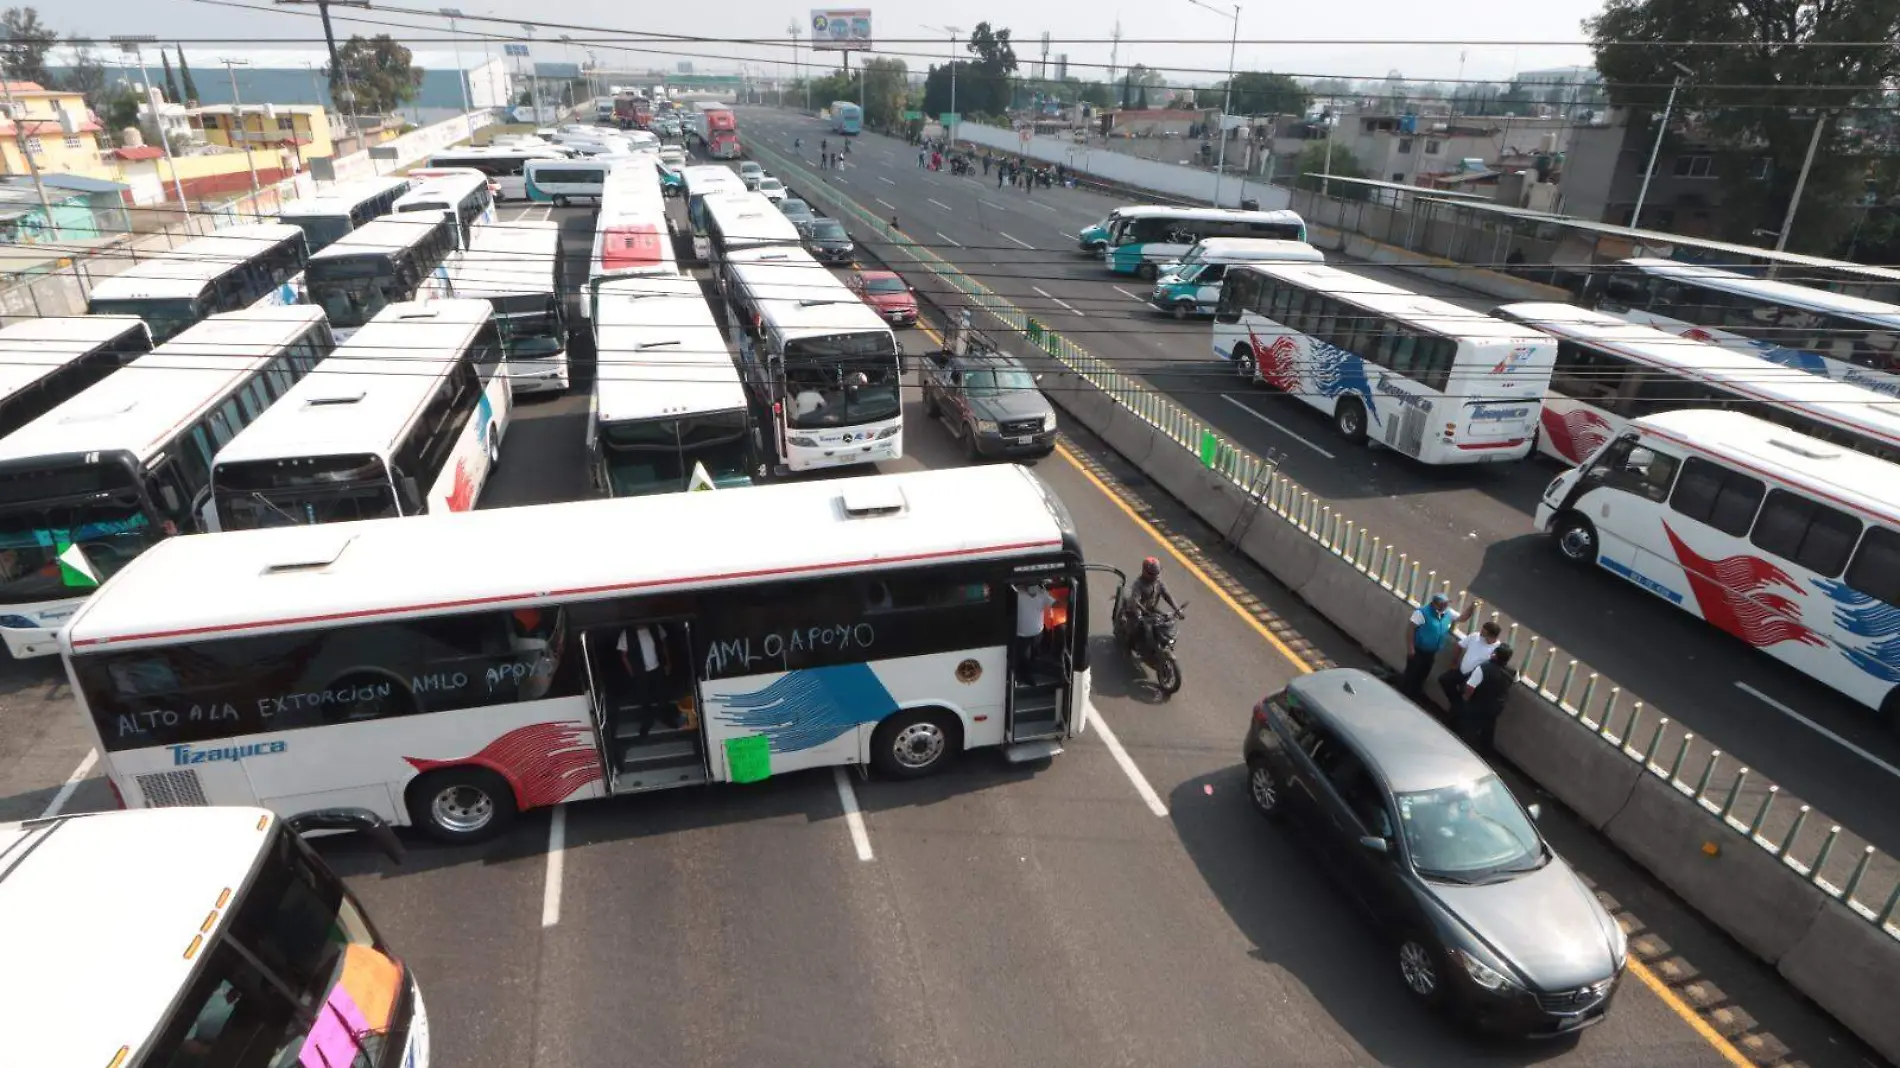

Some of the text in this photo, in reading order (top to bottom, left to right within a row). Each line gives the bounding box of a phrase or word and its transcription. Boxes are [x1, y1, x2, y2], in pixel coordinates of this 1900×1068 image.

[705, 623, 875, 673] AMLO APOYO
[118, 709, 178, 737] ALTO
[190, 707, 202, 721] A
[209, 703, 239, 721] LA
[411, 672, 468, 694] AMLO
[166, 740, 287, 766] Tizayuca
